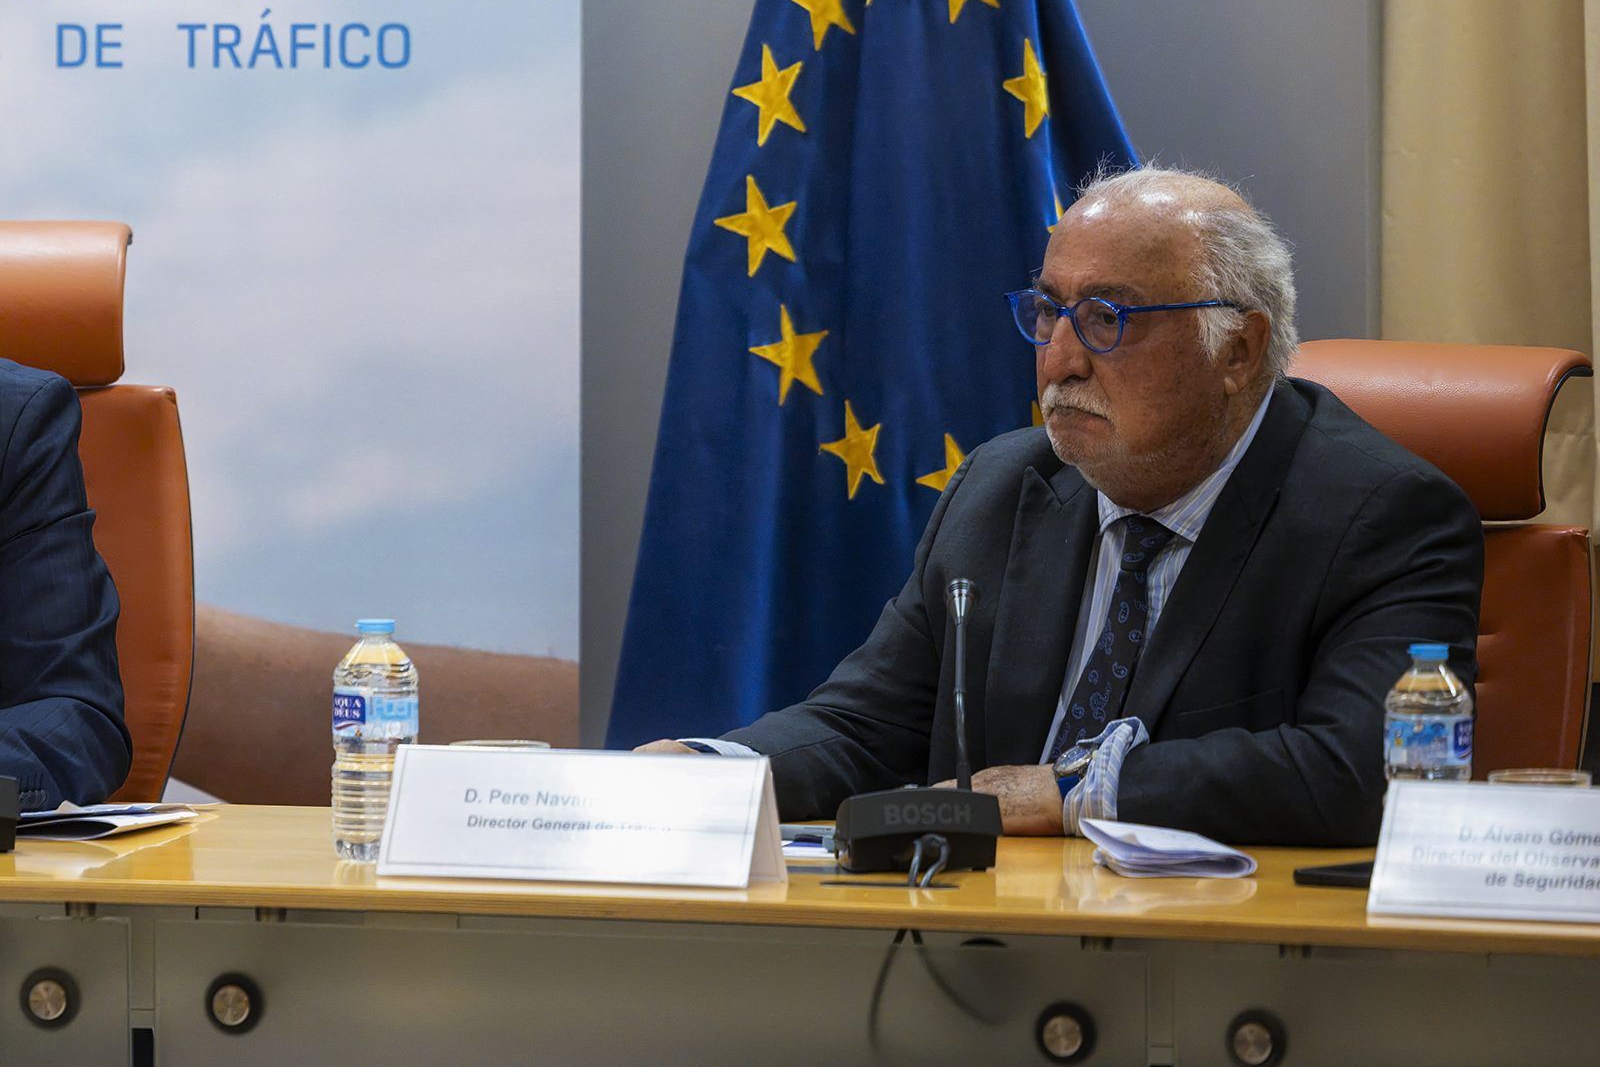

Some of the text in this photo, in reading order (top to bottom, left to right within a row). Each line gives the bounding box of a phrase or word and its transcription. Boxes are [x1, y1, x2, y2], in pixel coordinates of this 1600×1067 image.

[55, 23, 124, 69] DE
[177, 8, 412, 69] TRÁFICO
[464, 788, 482, 804] D.
[488, 789, 530, 806] Pere
[466, 814, 528, 829] Director
[531, 818, 591, 832] General
[883, 802, 972, 826] BOSCH
[1458, 825, 1477, 843] D.
[1484, 823, 1543, 844] Álvaro
[1412, 844, 1485, 865] Director
[1491, 850, 1518, 866] del
[1485, 871, 1507, 887] de
